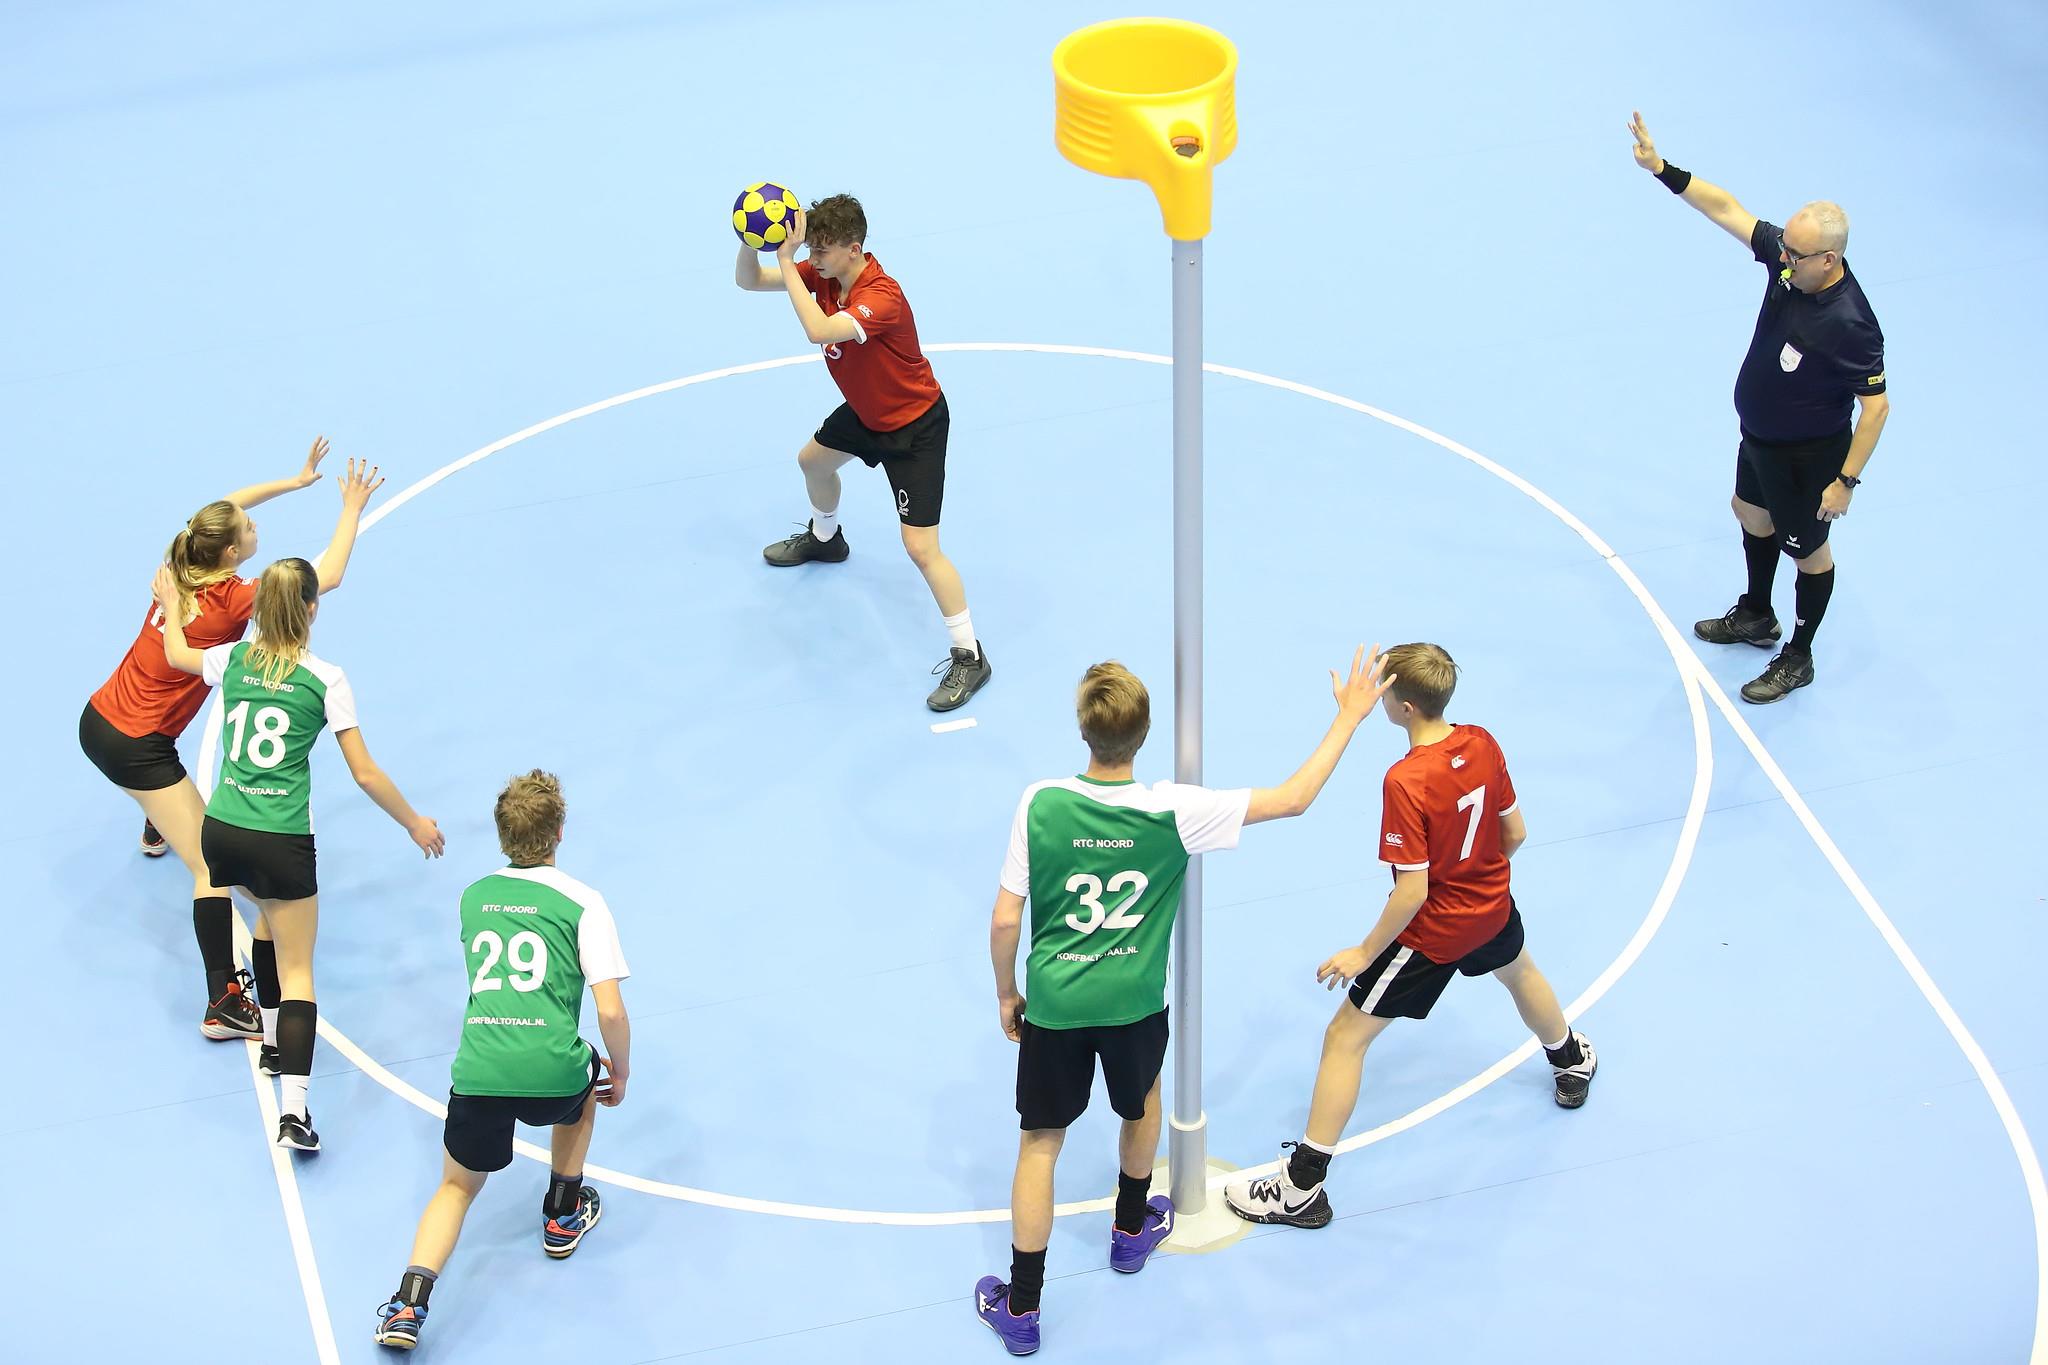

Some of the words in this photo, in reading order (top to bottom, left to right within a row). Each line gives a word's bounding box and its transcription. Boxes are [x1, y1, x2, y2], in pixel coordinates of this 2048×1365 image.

[262, 680, 294, 692] OORD
[227, 701, 290, 768] 18
[1073, 839, 1094, 848] RTC
[1096, 839, 1134, 848] NOORD
[1457, 785, 1486, 862] 7
[503, 904, 537, 914] NOORD
[1065, 870, 1149, 935] 32
[471, 930, 548, 993] 29
